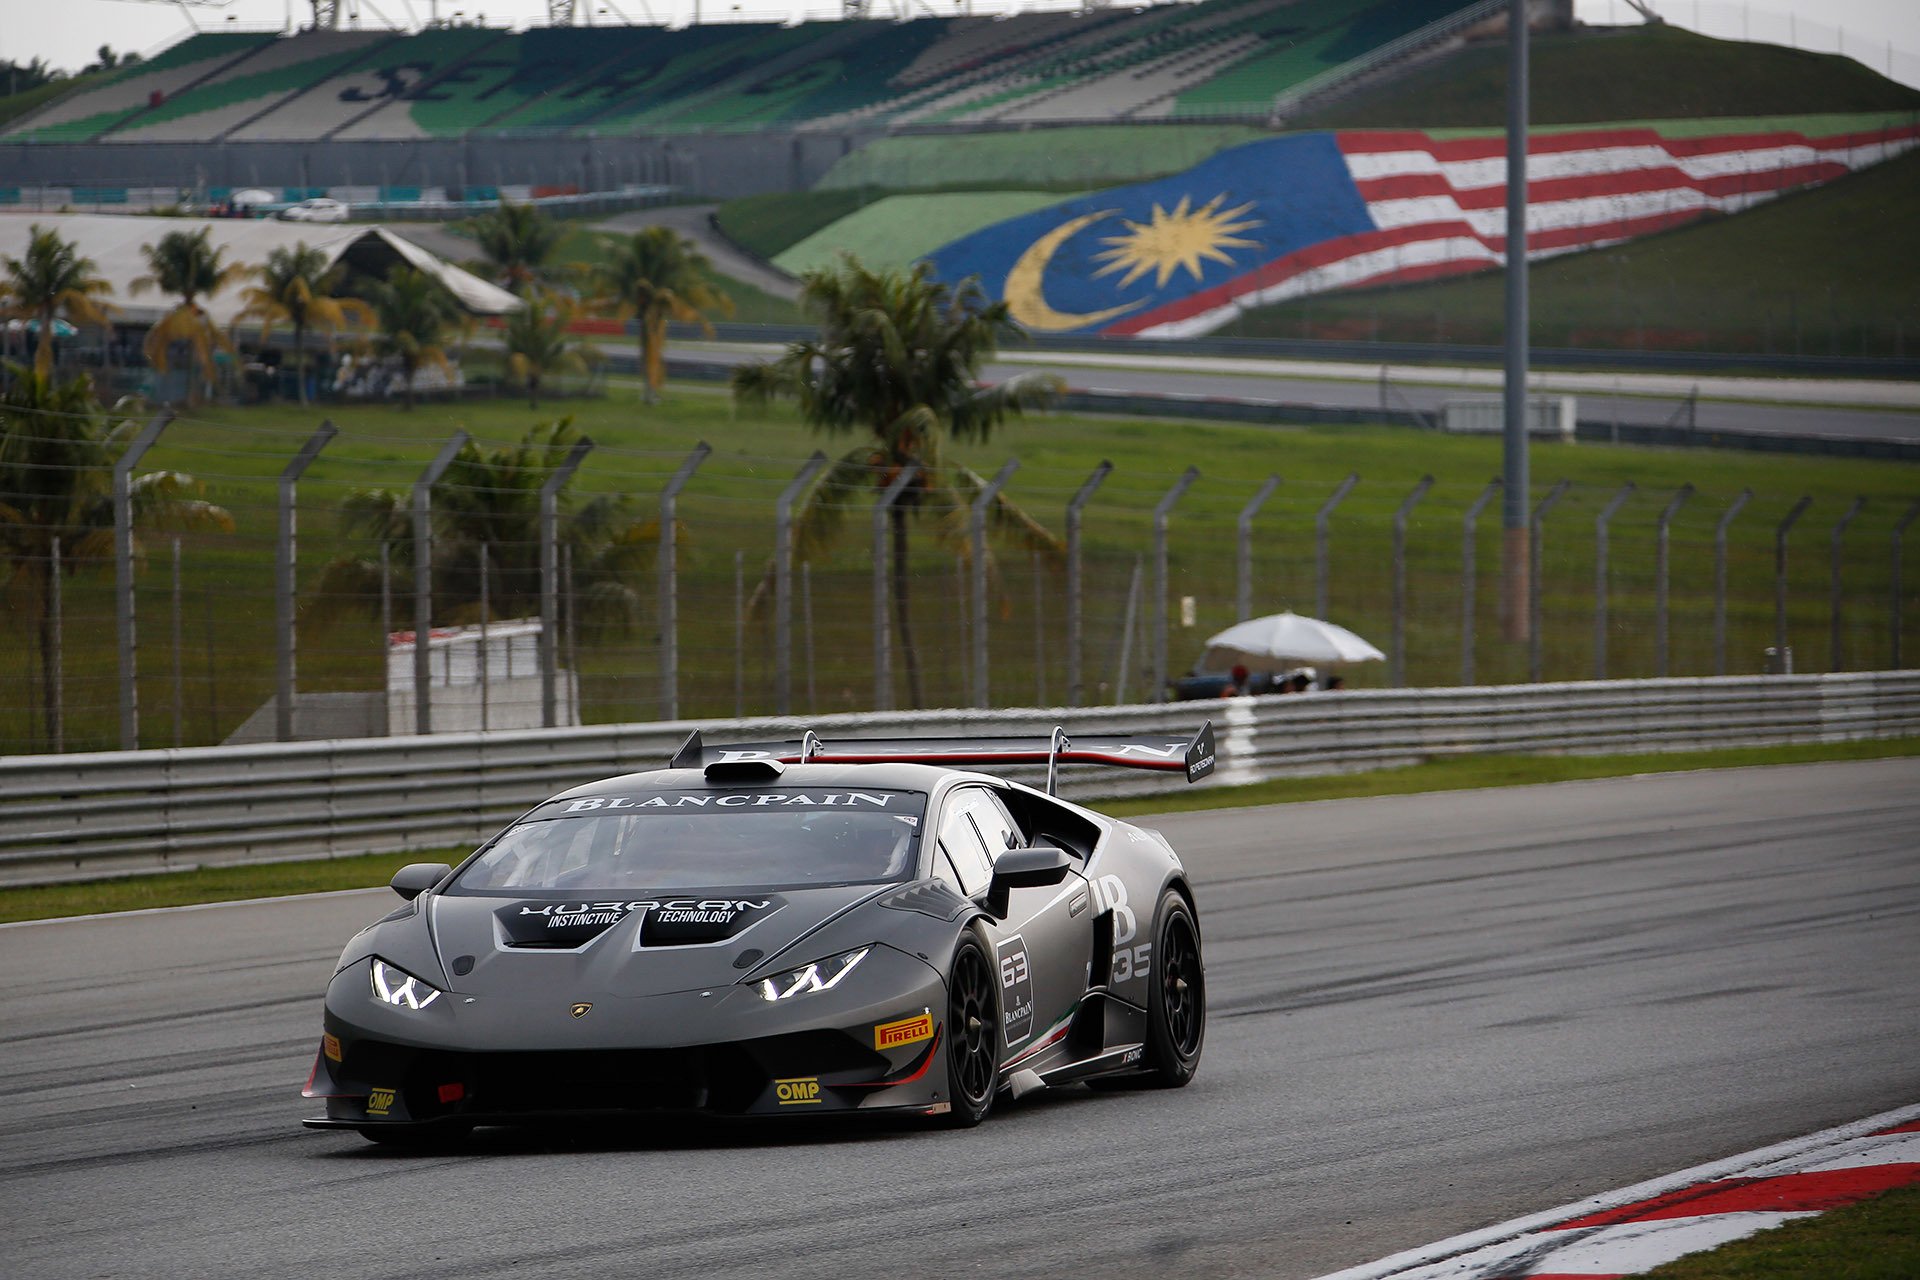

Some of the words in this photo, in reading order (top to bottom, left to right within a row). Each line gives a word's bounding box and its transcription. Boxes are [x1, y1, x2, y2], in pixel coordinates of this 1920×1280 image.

[561, 793, 895, 813] BLANCPAIN
[547, 912, 622, 928] INSTINCTIVE
[657, 910, 736, 923] TECHNOLOGY
[1001, 951, 1028, 989] 63
[880, 1018, 929, 1045] PIRELLI
[776, 1082, 820, 1100] OMP
[368, 1092, 394, 1110] OMP
